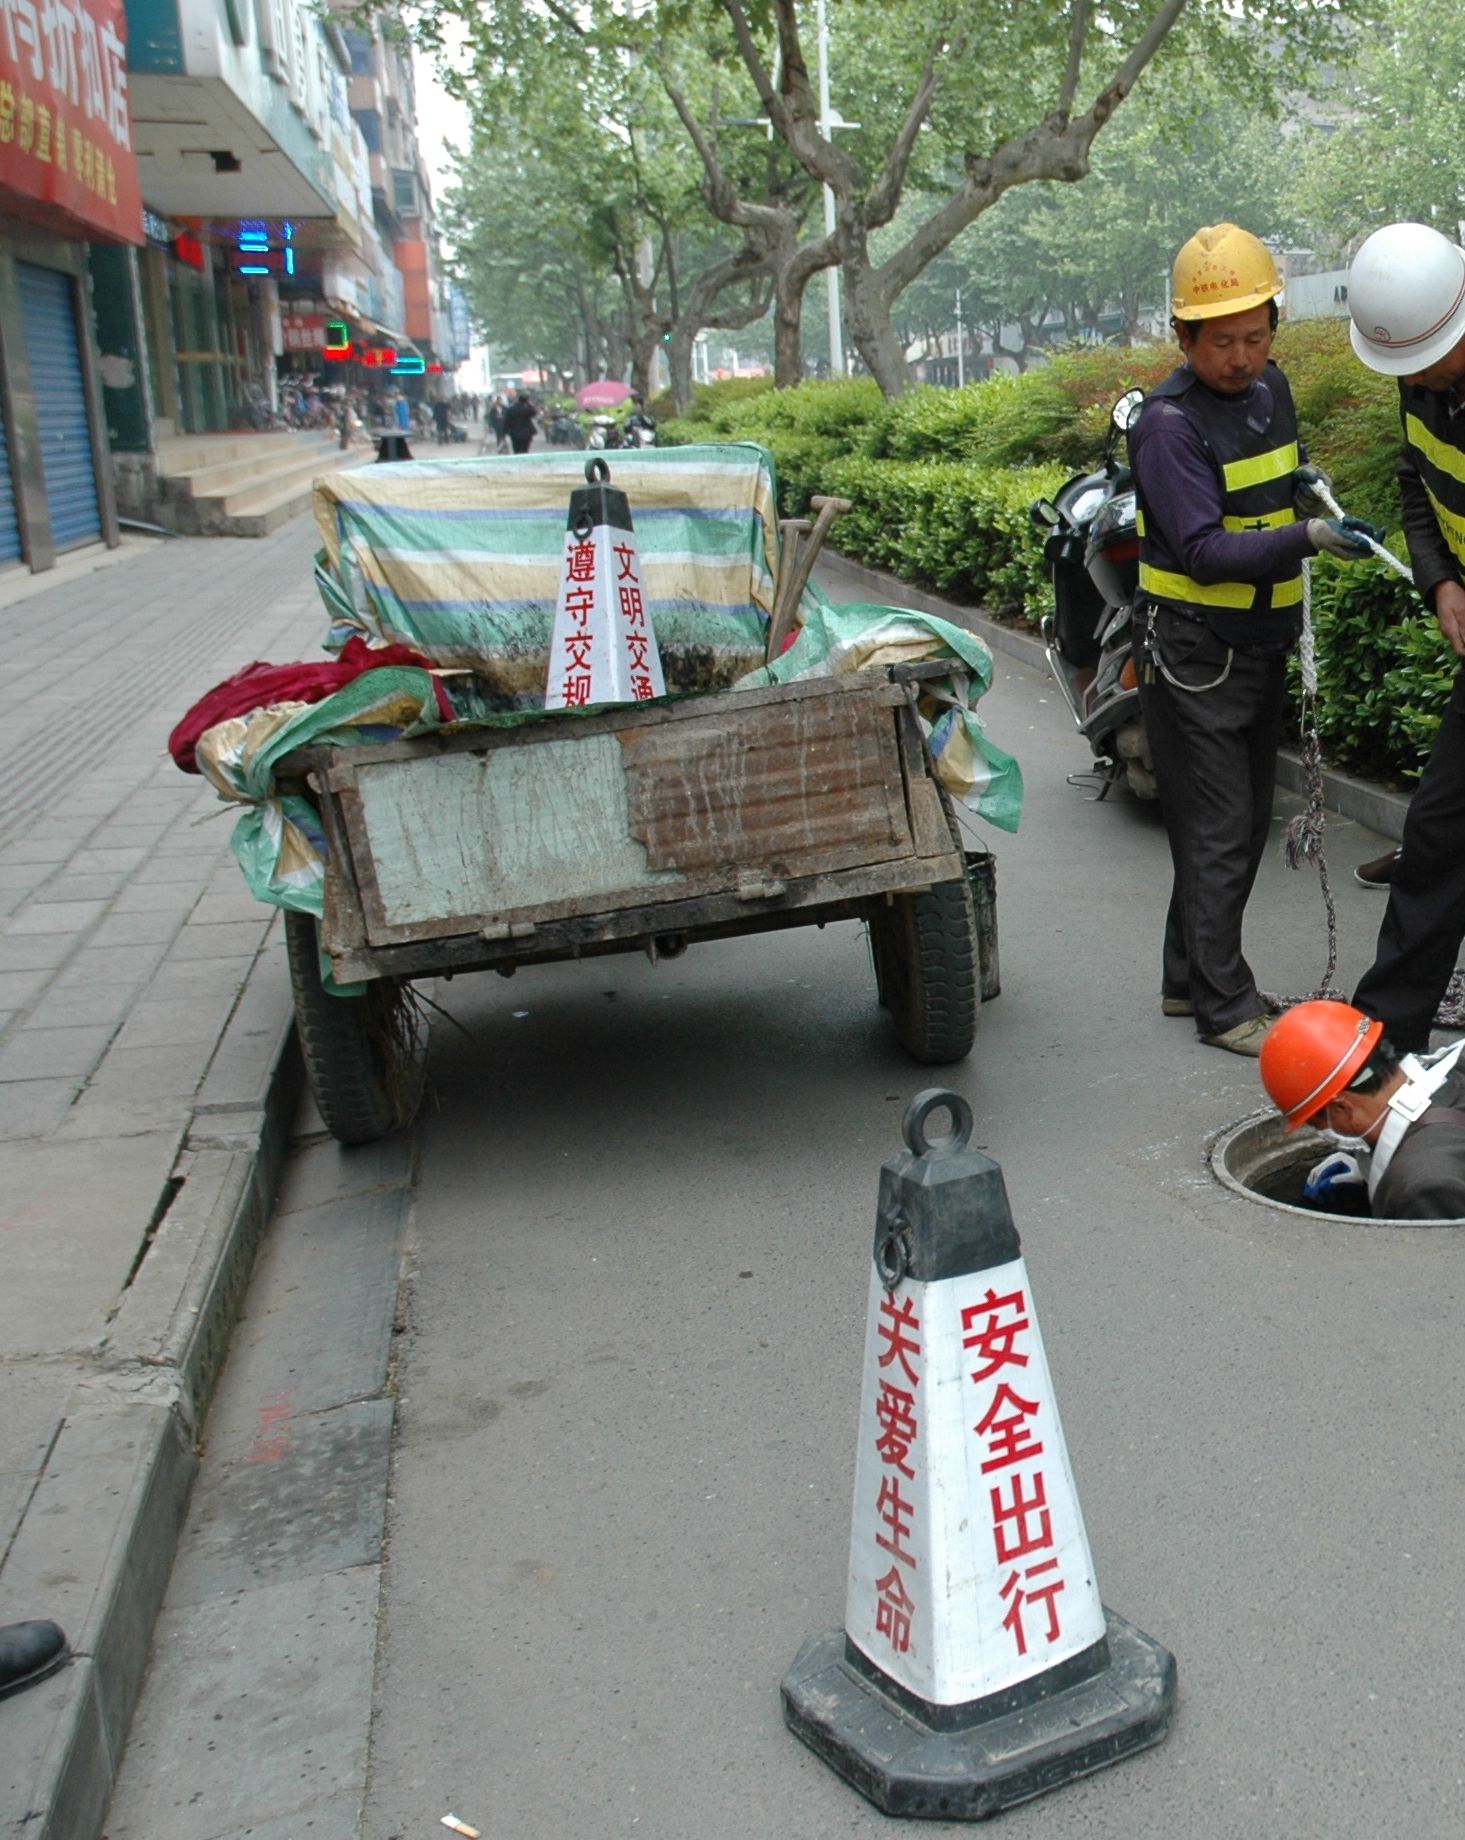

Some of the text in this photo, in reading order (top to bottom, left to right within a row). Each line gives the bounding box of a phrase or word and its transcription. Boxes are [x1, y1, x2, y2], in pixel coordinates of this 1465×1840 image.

[562, 540, 596, 707] 遵守交规
[613, 542, 656, 701] 文明交通
[875, 1290, 922, 1655] 关爱生命
[960, 1287, 1066, 1656] 安全出行
